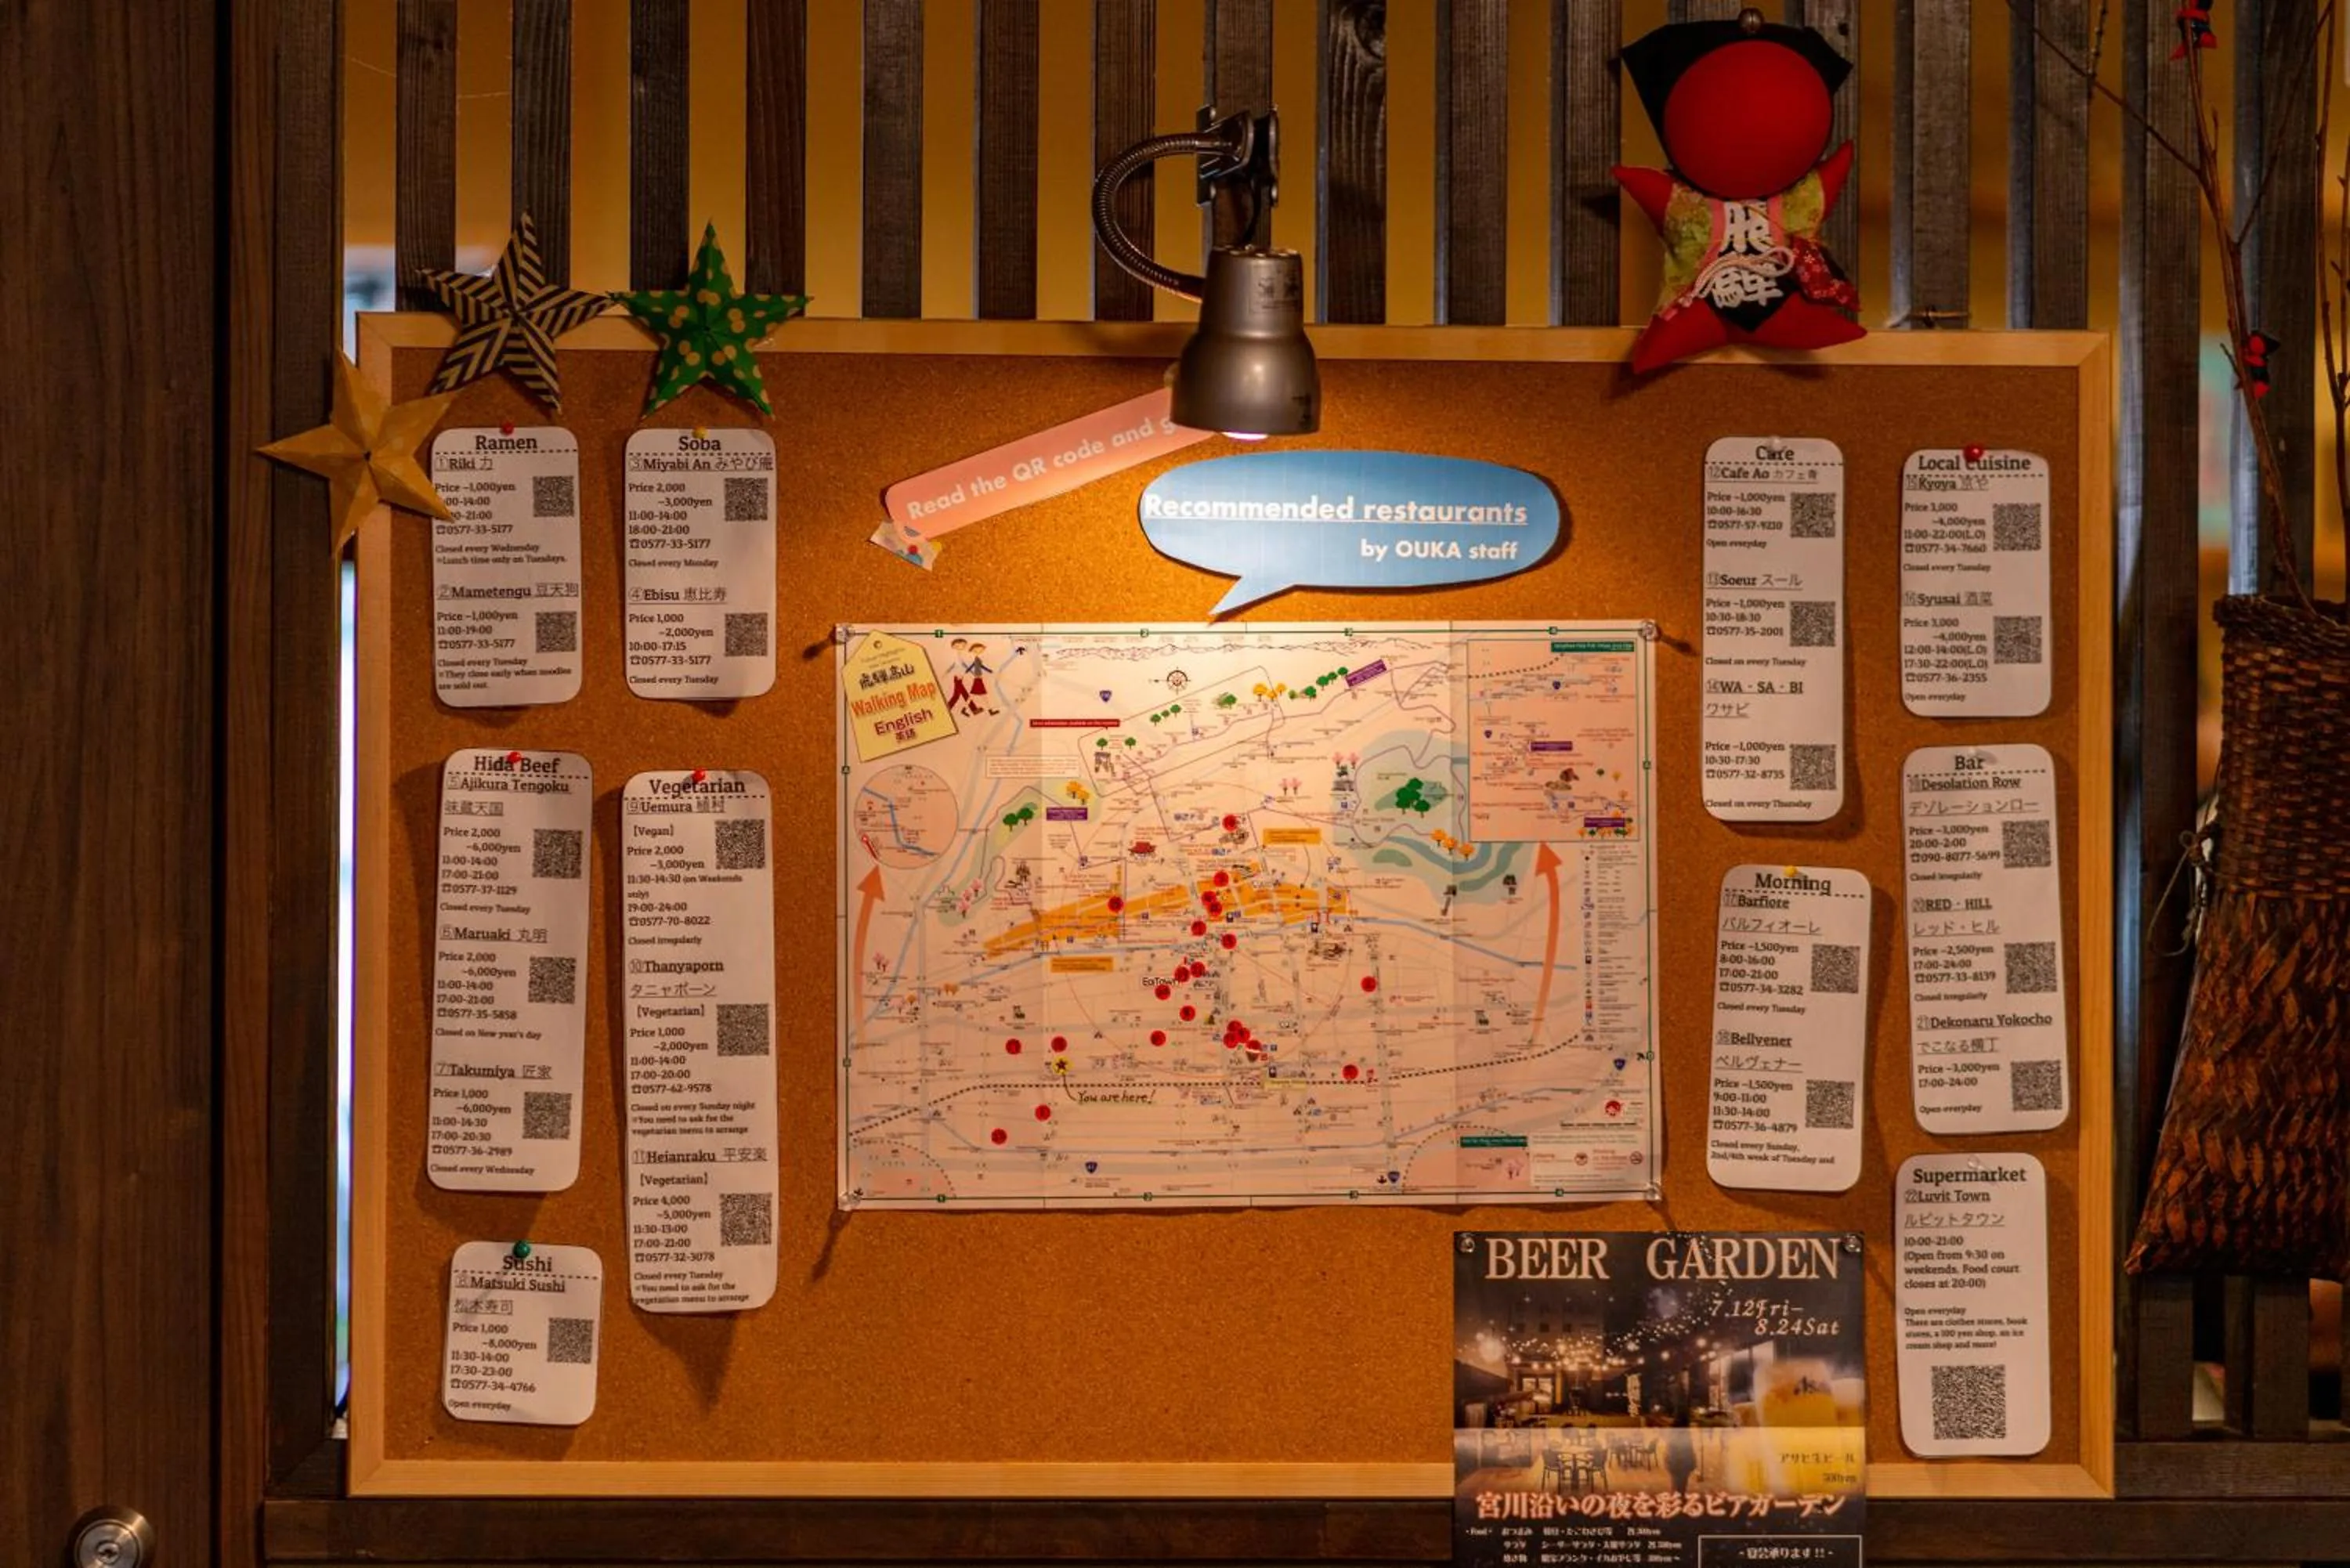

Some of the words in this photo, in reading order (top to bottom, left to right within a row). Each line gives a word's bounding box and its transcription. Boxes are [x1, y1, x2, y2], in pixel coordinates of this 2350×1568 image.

[475, 435, 537, 450] Ramen
[678, 436, 721, 451] Soba
[1755, 446, 1795, 461] Cafe
[449, 457, 475, 470] Riki
[644, 459, 689, 471] Miyabi
[692, 459, 710, 469] An
[906, 486, 966, 519] Read
[971, 477, 1007, 498] the
[1012, 457, 1047, 483] QR
[1052, 439, 1104, 468] code
[1112, 417, 1153, 447] and
[1918, 455, 1959, 470] Local
[1721, 468, 1748, 479] Cafe
[1752, 468, 1770, 479] Ao
[435, 482, 459, 493] Price
[629, 483, 654, 493] Price
[656, 483, 685, 493] 2,000
[1918, 479, 1956, 490] Kyoya
[1144, 493, 1354, 520] Recommended
[1364, 500, 1528, 523] restaurants
[629, 511, 687, 521] 11:00-14:00
[446, 525, 513, 534] 0577-33-5177
[629, 526, 689, 535] 18:00-21:00
[642, 540, 710, 548] 0577-33-5177
[1361, 539, 1386, 562] by
[1396, 540, 1461, 558] OUKA
[1469, 542, 1518, 560] staff
[1719, 575, 1756, 586] Soeur
[451, 587, 531, 599] Mametengu
[644, 589, 679, 601] Ebisu
[1918, 594, 1961, 605] Syusai
[438, 612, 463, 621] Price
[629, 614, 654, 623] Price
[449, 640, 515, 649] 0577-33-5177
[642, 656, 711, 665] 0577-33-5177
[1719, 681, 1742, 693] WA
[1757, 681, 1774, 693] SA
[1790, 682, 1803, 693] BI
[851, 691, 906, 717] Walking
[906, 681, 936, 703] Map
[1706, 703, 1748, 716] ワサビ
[874, 708, 933, 735] English
[474, 756, 515, 772] Hida
[521, 758, 560, 773] Beef
[1955, 756, 1985, 770] Bar
[461, 778, 508, 791] Ajikura
[512, 780, 569, 793] Tengoku
[649, 779, 746, 799] Vegetarian
[1922, 779, 1989, 789] Desolation
[1992, 777, 2021, 788] Row
[642, 802, 692, 812] Uemura
[443, 827, 469, 836] Price
[471, 828, 501, 837] 2,000
[627, 846, 652, 855] Price
[1755, 873, 1831, 896] Morning
[1738, 895, 1790, 909] Barfiore
[1926, 899, 1951, 910] RED
[1965, 898, 1992, 909] HILL
[454, 927, 510, 940] Maruaki
[645, 960, 724, 974] Thanyaporn
[1931, 1016, 1994, 1028] Dekonaru
[1997, 1013, 2052, 1026] Yokocho
[1731, 1032, 1792, 1048] Bellvener
[450, 1064, 515, 1079] Takumiya
[1078, 1090, 1097, 1105] You
[1123, 1089, 1155, 1104] here!
[647, 1151, 715, 1163] Heianraku
[1913, 1167, 2026, 1187] Supermarket
[1919, 1190, 1950, 1202] Luvit
[1956, 1190, 1990, 1202] Town
[1484, 1237, 1610, 1279] BEER
[1647, 1237, 1841, 1279] GARDEN
[1936, 1251, 1962, 1259] from
[503, 1255, 552, 1272] Sushi
[1962, 1264, 1988, 1273] Food
[470, 1277, 526, 1291] Matsuki
[530, 1280, 566, 1292] Sushi
[453, 1323, 478, 1331] Price
[1477, 1493, 1846, 1519] 宮川沿いの夜を彩るビアガーデン
